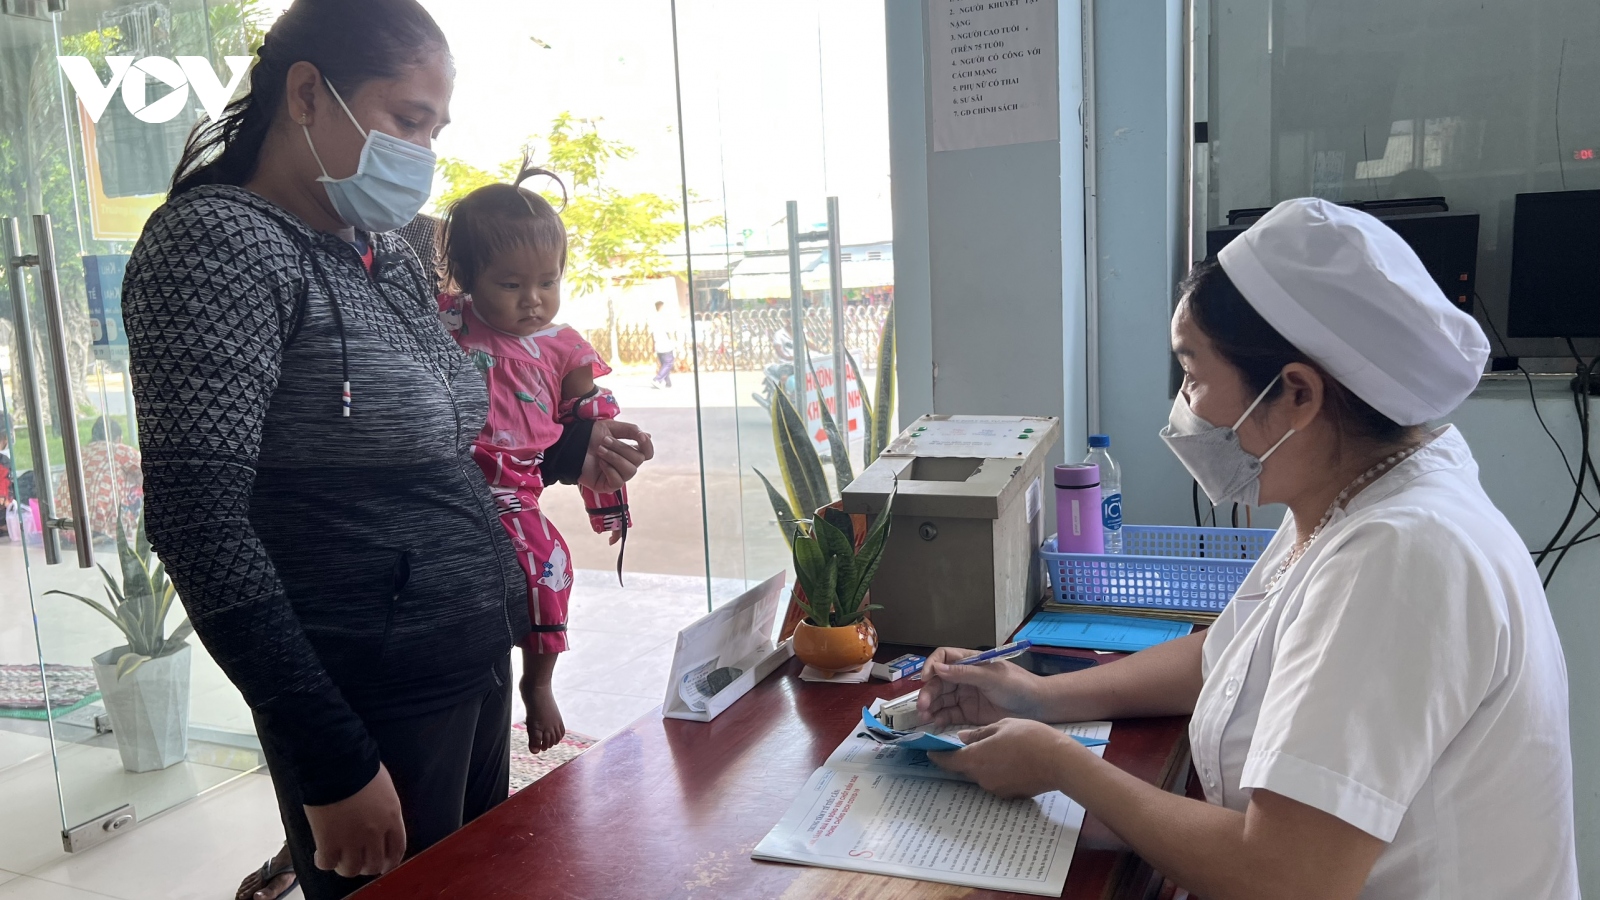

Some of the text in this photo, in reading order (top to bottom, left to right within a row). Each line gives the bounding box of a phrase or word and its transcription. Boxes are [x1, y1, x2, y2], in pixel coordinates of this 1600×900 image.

[960, 4, 983, 14] NGƯỜI
[958, 30, 981, 40] NGƯỜI
[951, 44, 972, 54] (TRÊN
[961, 56, 984, 65] NGƯỜI
[1002, 51, 1023, 59] CÔNG
[1027, 47, 1040, 56] VỚI
[952, 68, 997, 79] CÁCH MẠNG
[976, 81, 987, 89] NỮ
[1001, 78, 1019, 86] THAI
[973, 105, 996, 114] CHÍNH
[998, 104, 1018, 112] SÁCH
